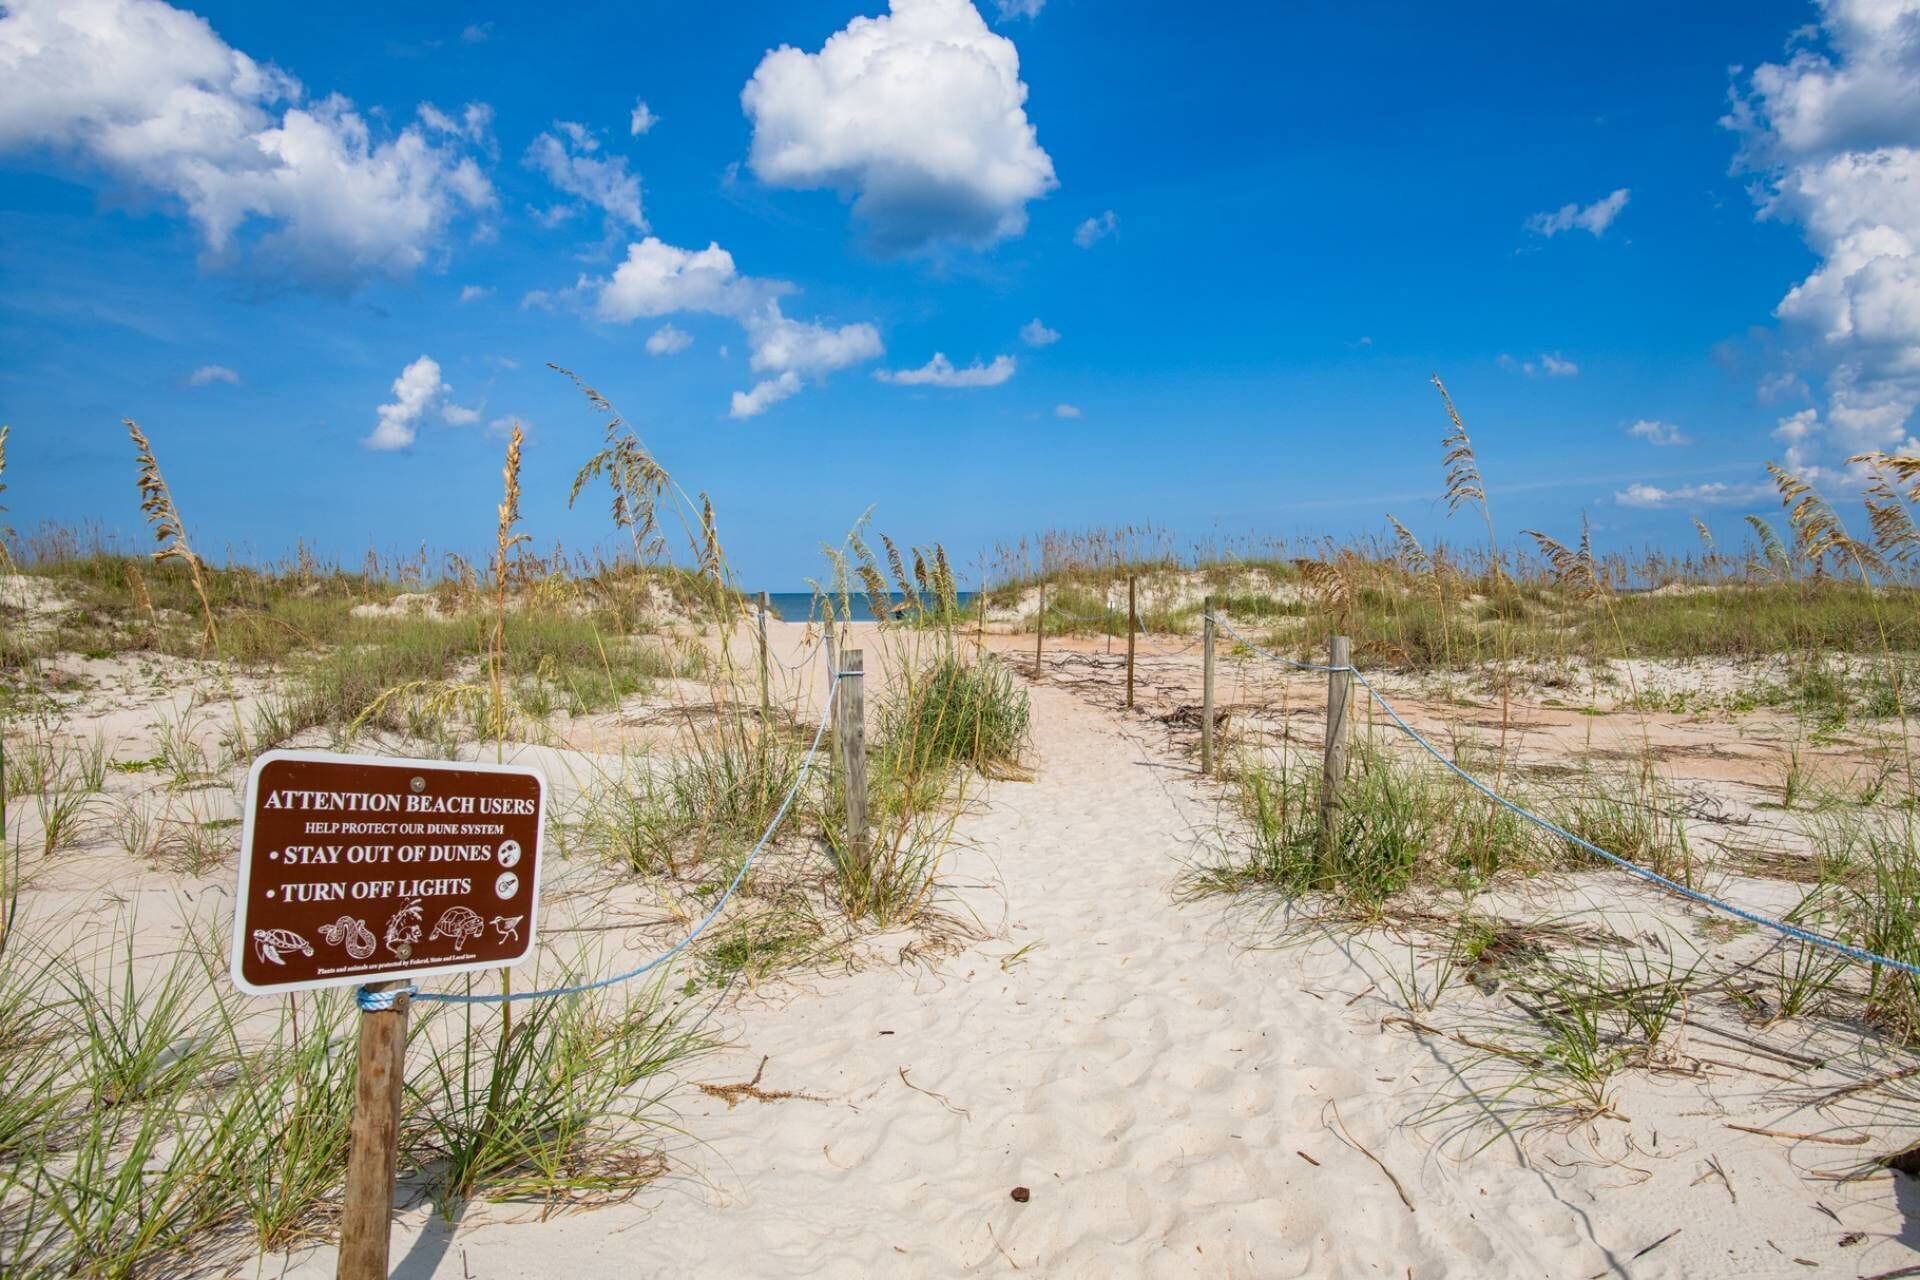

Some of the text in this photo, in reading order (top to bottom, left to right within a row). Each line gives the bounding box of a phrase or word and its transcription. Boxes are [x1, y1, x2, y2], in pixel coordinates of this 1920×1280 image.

[264, 790, 535, 815] ATTENTION BEACH USERS
[305, 822, 504, 835] HELP PROTECT OUR DUNE SYSTEM
[284, 845, 491, 865] STAY OUT OF DUNES
[281, 878, 471, 902] TURN OFF LIGHTS
[347, 964, 368, 972] animals
[378, 960, 402, 970] protected
